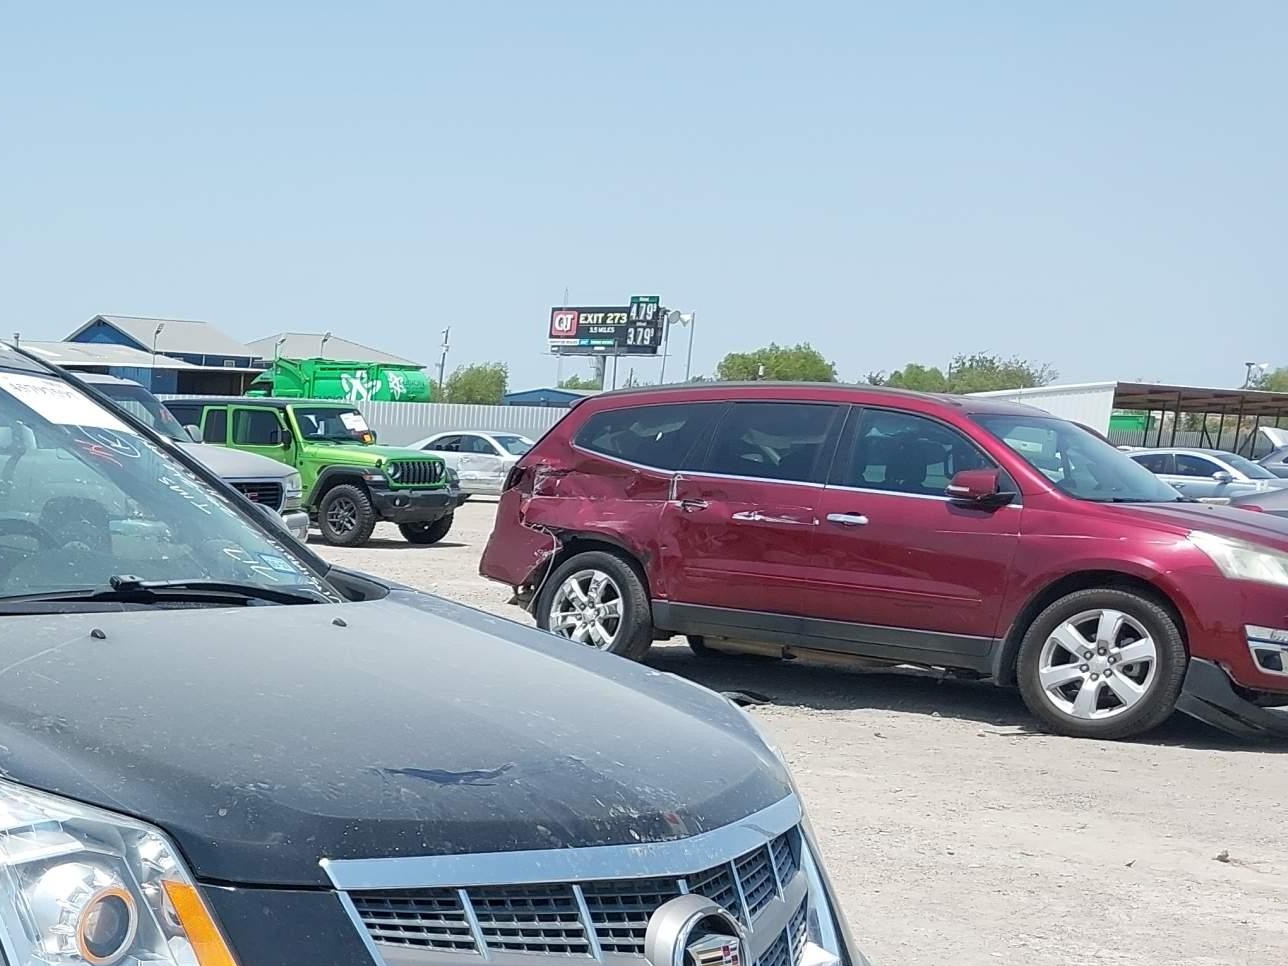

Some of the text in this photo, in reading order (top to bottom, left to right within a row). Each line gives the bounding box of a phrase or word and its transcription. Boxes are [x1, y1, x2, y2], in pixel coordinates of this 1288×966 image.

[554, 314, 574, 331] QT
[579, 313, 605, 324] EXIT
[606, 312, 627, 324] 273
